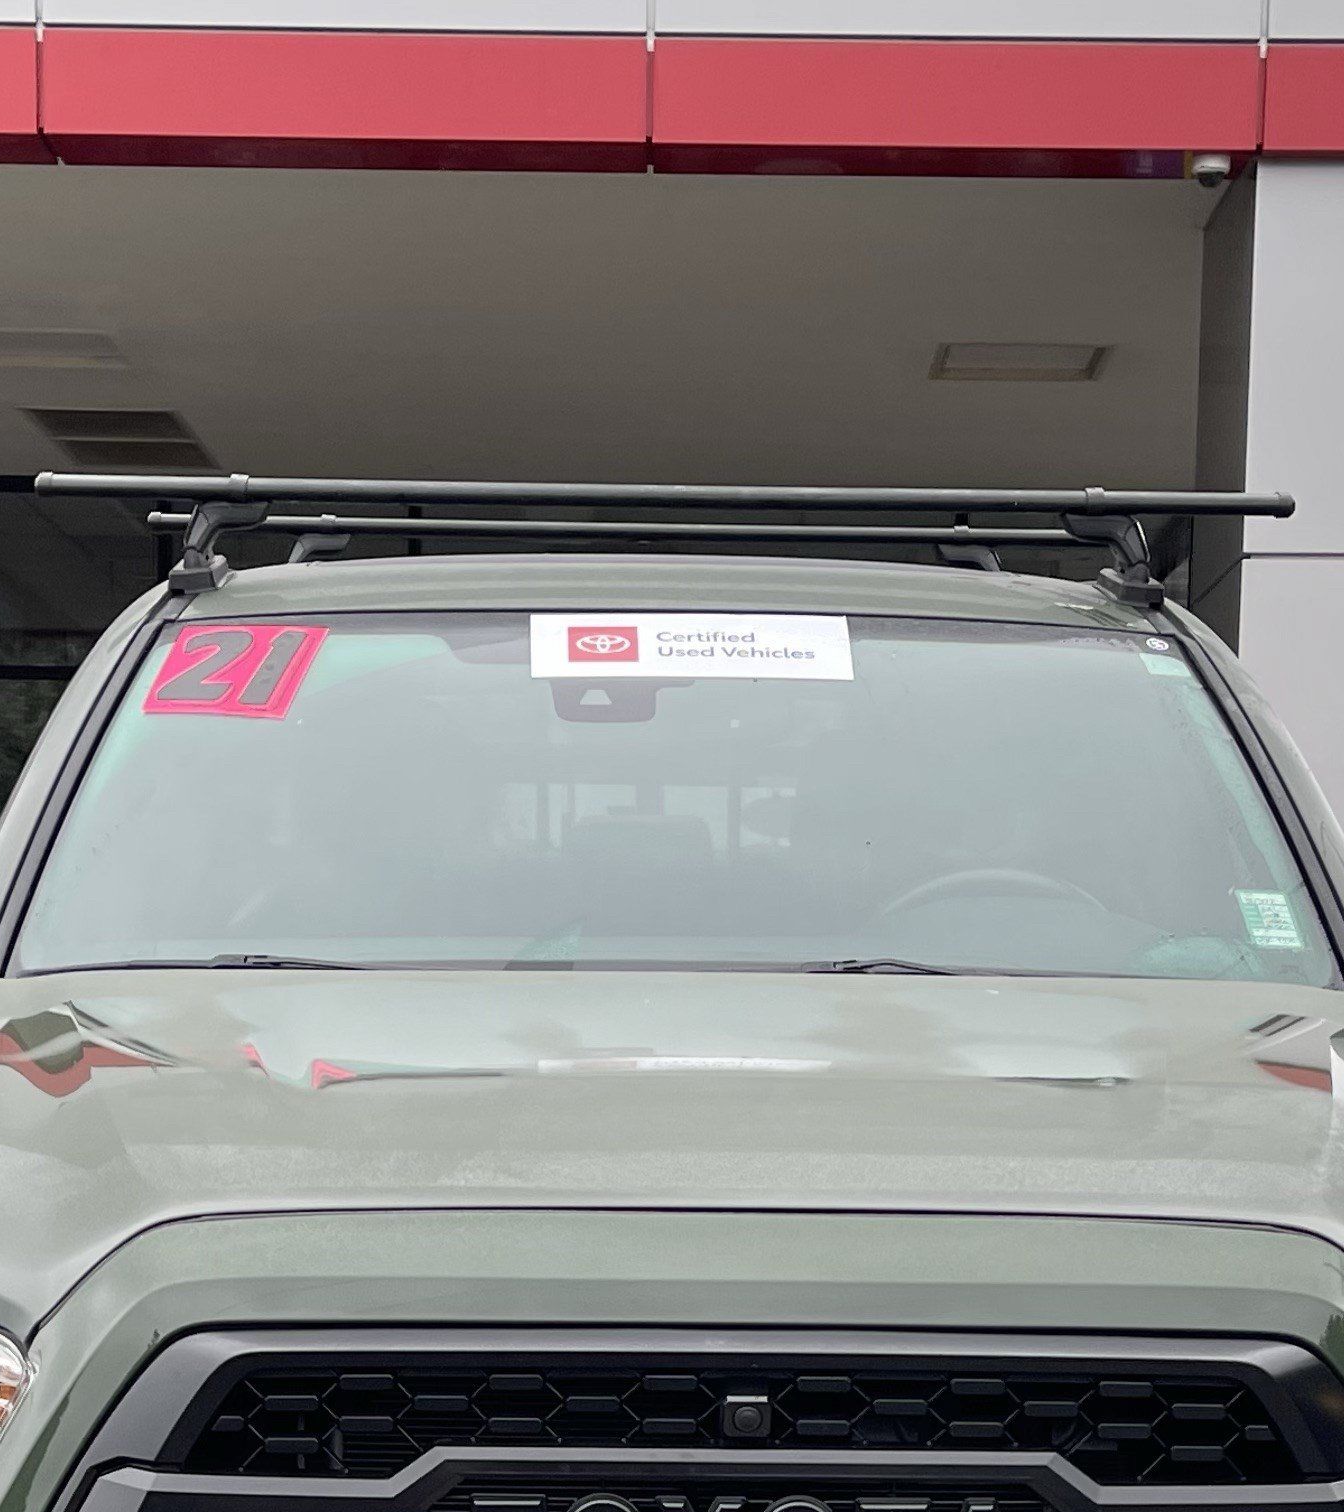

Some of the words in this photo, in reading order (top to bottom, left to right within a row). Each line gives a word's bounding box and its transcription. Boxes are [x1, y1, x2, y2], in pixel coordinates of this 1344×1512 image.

[656, 631, 756, 643] Certified
[657, 646, 714, 658] Used
[721, 646, 816, 660] Vehicles
[156, 631, 308, 705] 21
